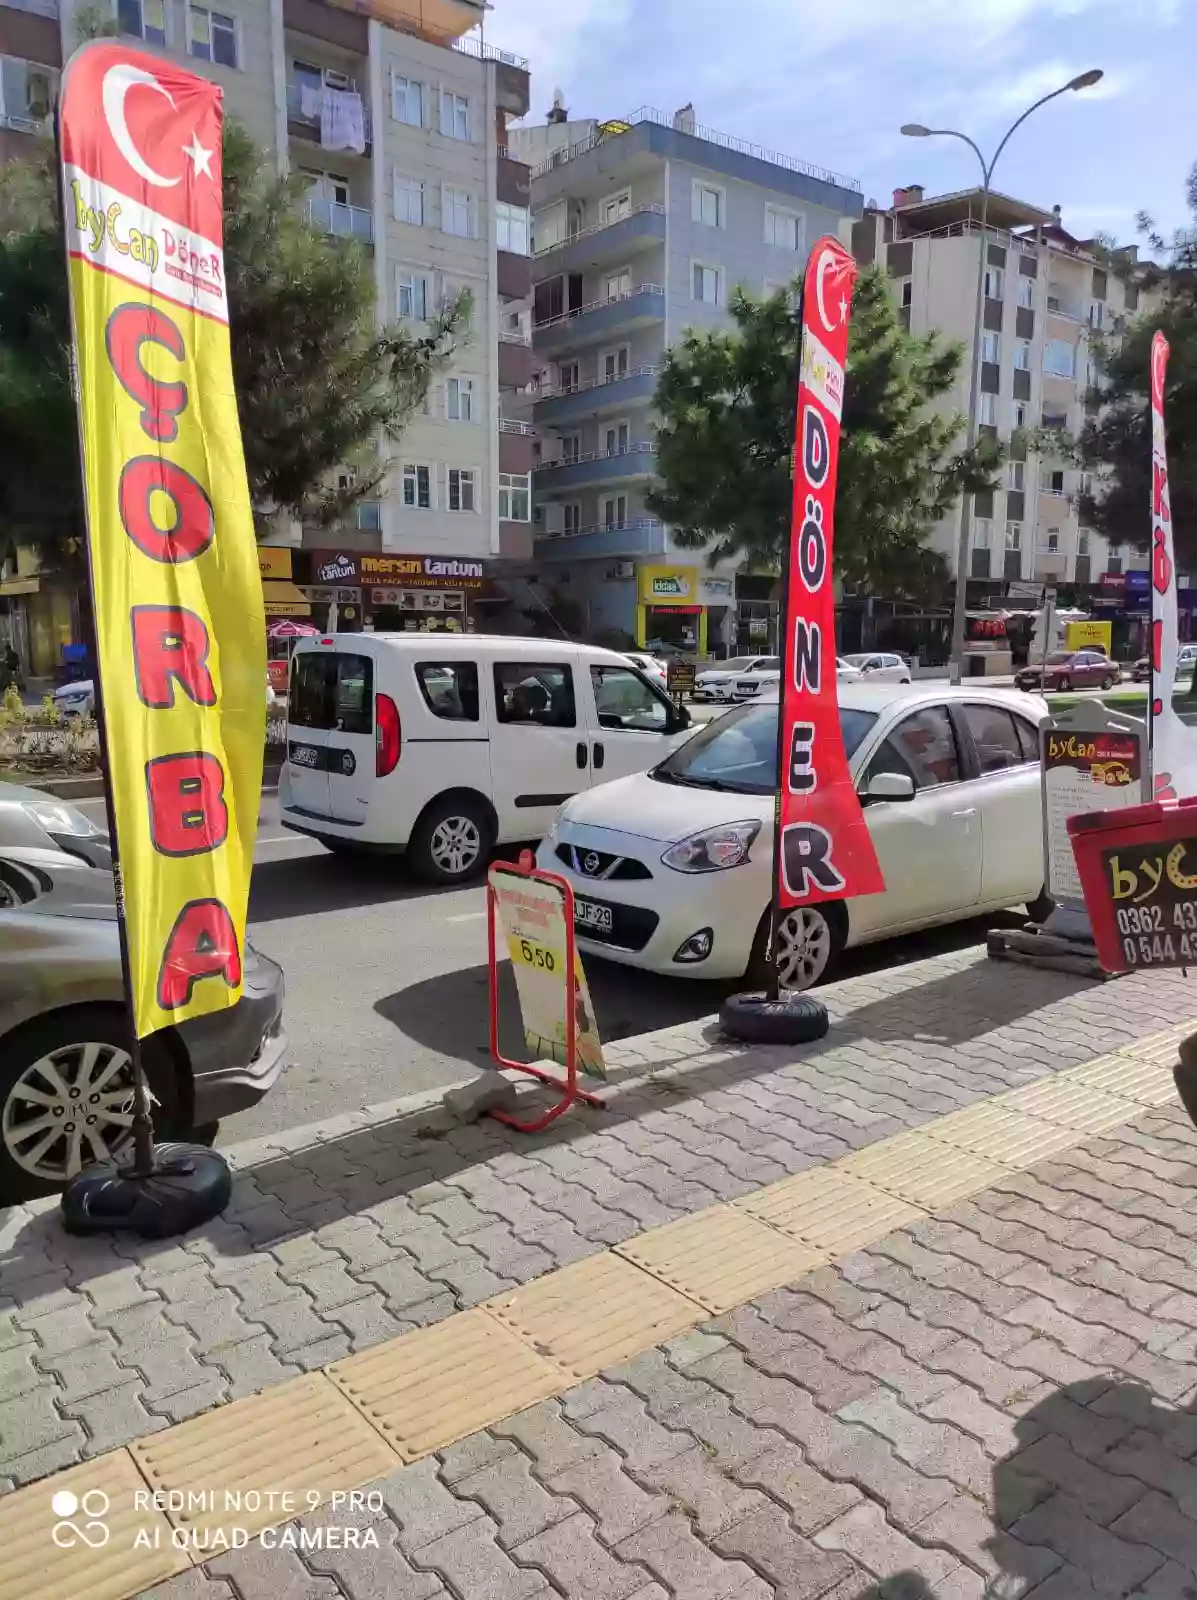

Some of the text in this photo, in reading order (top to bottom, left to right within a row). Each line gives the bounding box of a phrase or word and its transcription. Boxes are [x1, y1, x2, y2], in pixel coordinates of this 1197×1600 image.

[70, 180, 159, 274] byCan
[360, 557, 422, 574] mersin
[424, 558, 483, 577] tantuni
[106, 303, 241, 1010] ÇORBA
[782, 404, 845, 898] DÖNER
[1048, 735, 1096, 759] byCan
[1117, 905, 1165, 935] 0362
